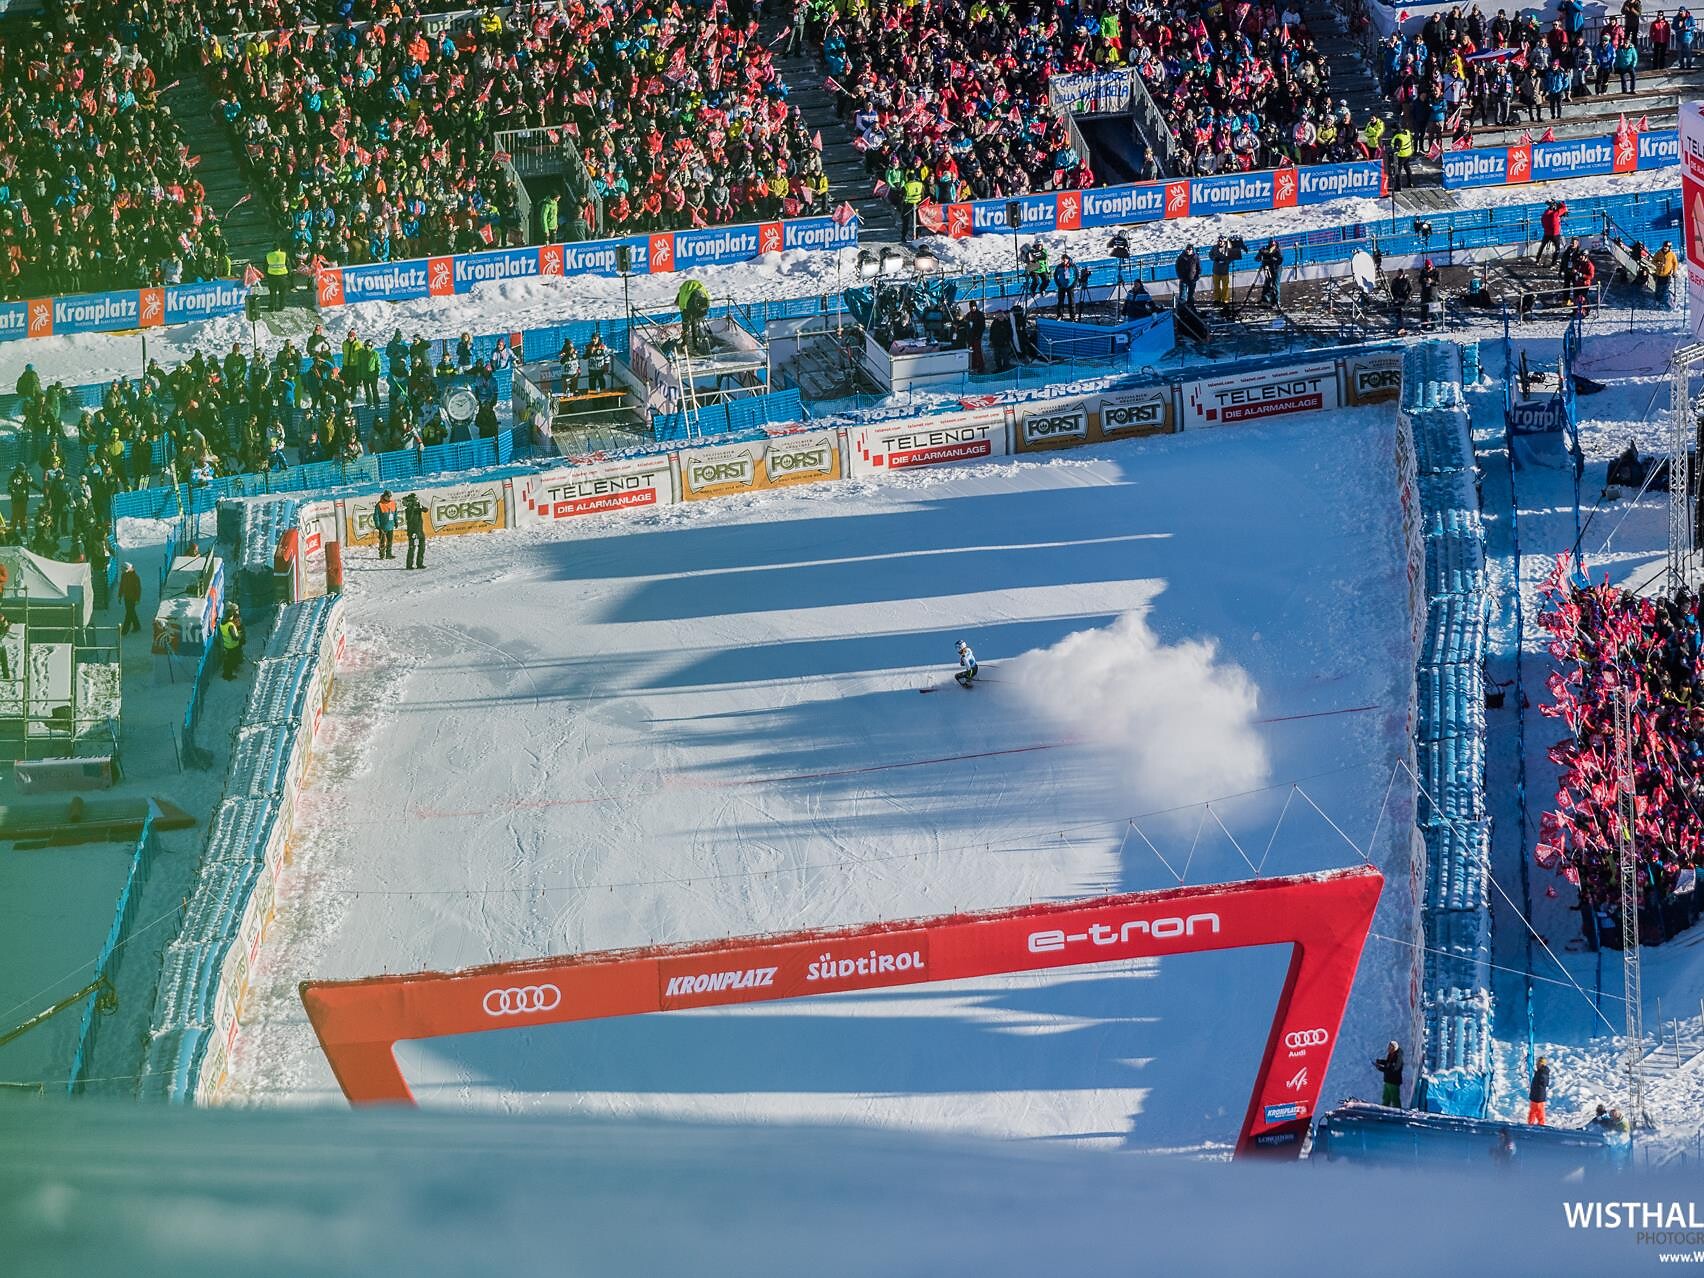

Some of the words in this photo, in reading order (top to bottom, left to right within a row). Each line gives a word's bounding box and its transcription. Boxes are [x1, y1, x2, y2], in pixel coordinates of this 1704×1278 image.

[1443, 154, 1504, 181] onplatz
[1534, 144, 1611, 170] Kronplatz
[1192, 179, 1271, 206] Kronplatz
[1300, 168, 1378, 194] Kronplatz
[975, 202, 1055, 228] Krolatz
[1083, 190, 1162, 217] Kronplatz
[565, 243, 647, 273] Kronptz
[676, 233, 757, 260] Kronplatz
[345, 267, 426, 295] Kronplatz
[455, 255, 537, 281] Kronplatz
[55, 297, 137, 325] Kronplatz
[167, 286, 248, 313] Kronplatz
[1215, 379, 1321, 405] TELENOT
[1105, 404, 1161, 426] FORST
[1225, 409, 1242, 419] DIE
[1244, 398, 1318, 416] ALARMANLAGE
[1511, 406, 1563, 431] ronpl
[882, 426, 990, 451] TELENOT
[1028, 414, 1083, 437] FORST
[771, 449, 825, 472] FORST
[892, 455, 909, 465] DIE
[911, 445, 987, 463] ALARMANLAGE
[693, 460, 748, 484] FORST
[548, 474, 655, 501] TELENOT
[436, 500, 491, 521] FORST
[557, 505, 574, 514] DIE
[576, 493, 652, 511] ALARMANLAGE
[1028, 912, 1220, 953] e-tron
[665, 967, 778, 997] KRONPLATZ
